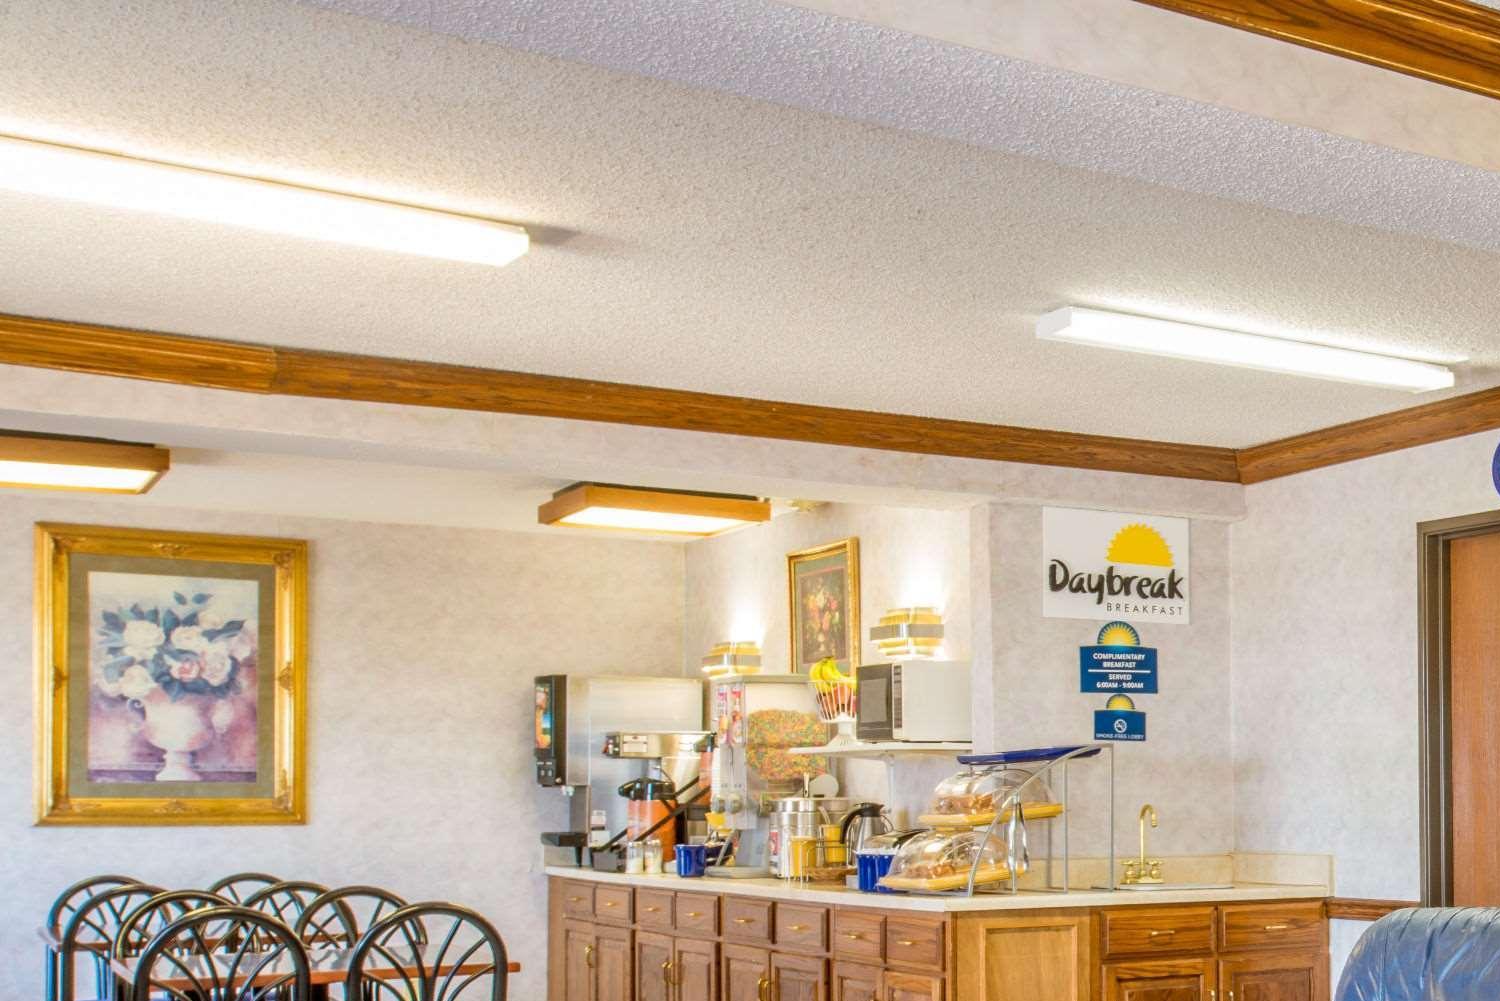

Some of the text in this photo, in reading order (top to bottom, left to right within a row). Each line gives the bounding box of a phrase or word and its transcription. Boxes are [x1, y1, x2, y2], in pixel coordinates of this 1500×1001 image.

[1048, 559, 1184, 605] Daybreak
[1106, 602, 1183, 616] BREAKFAST
[1092, 652, 1146, 661] COMPLIMENTARY
